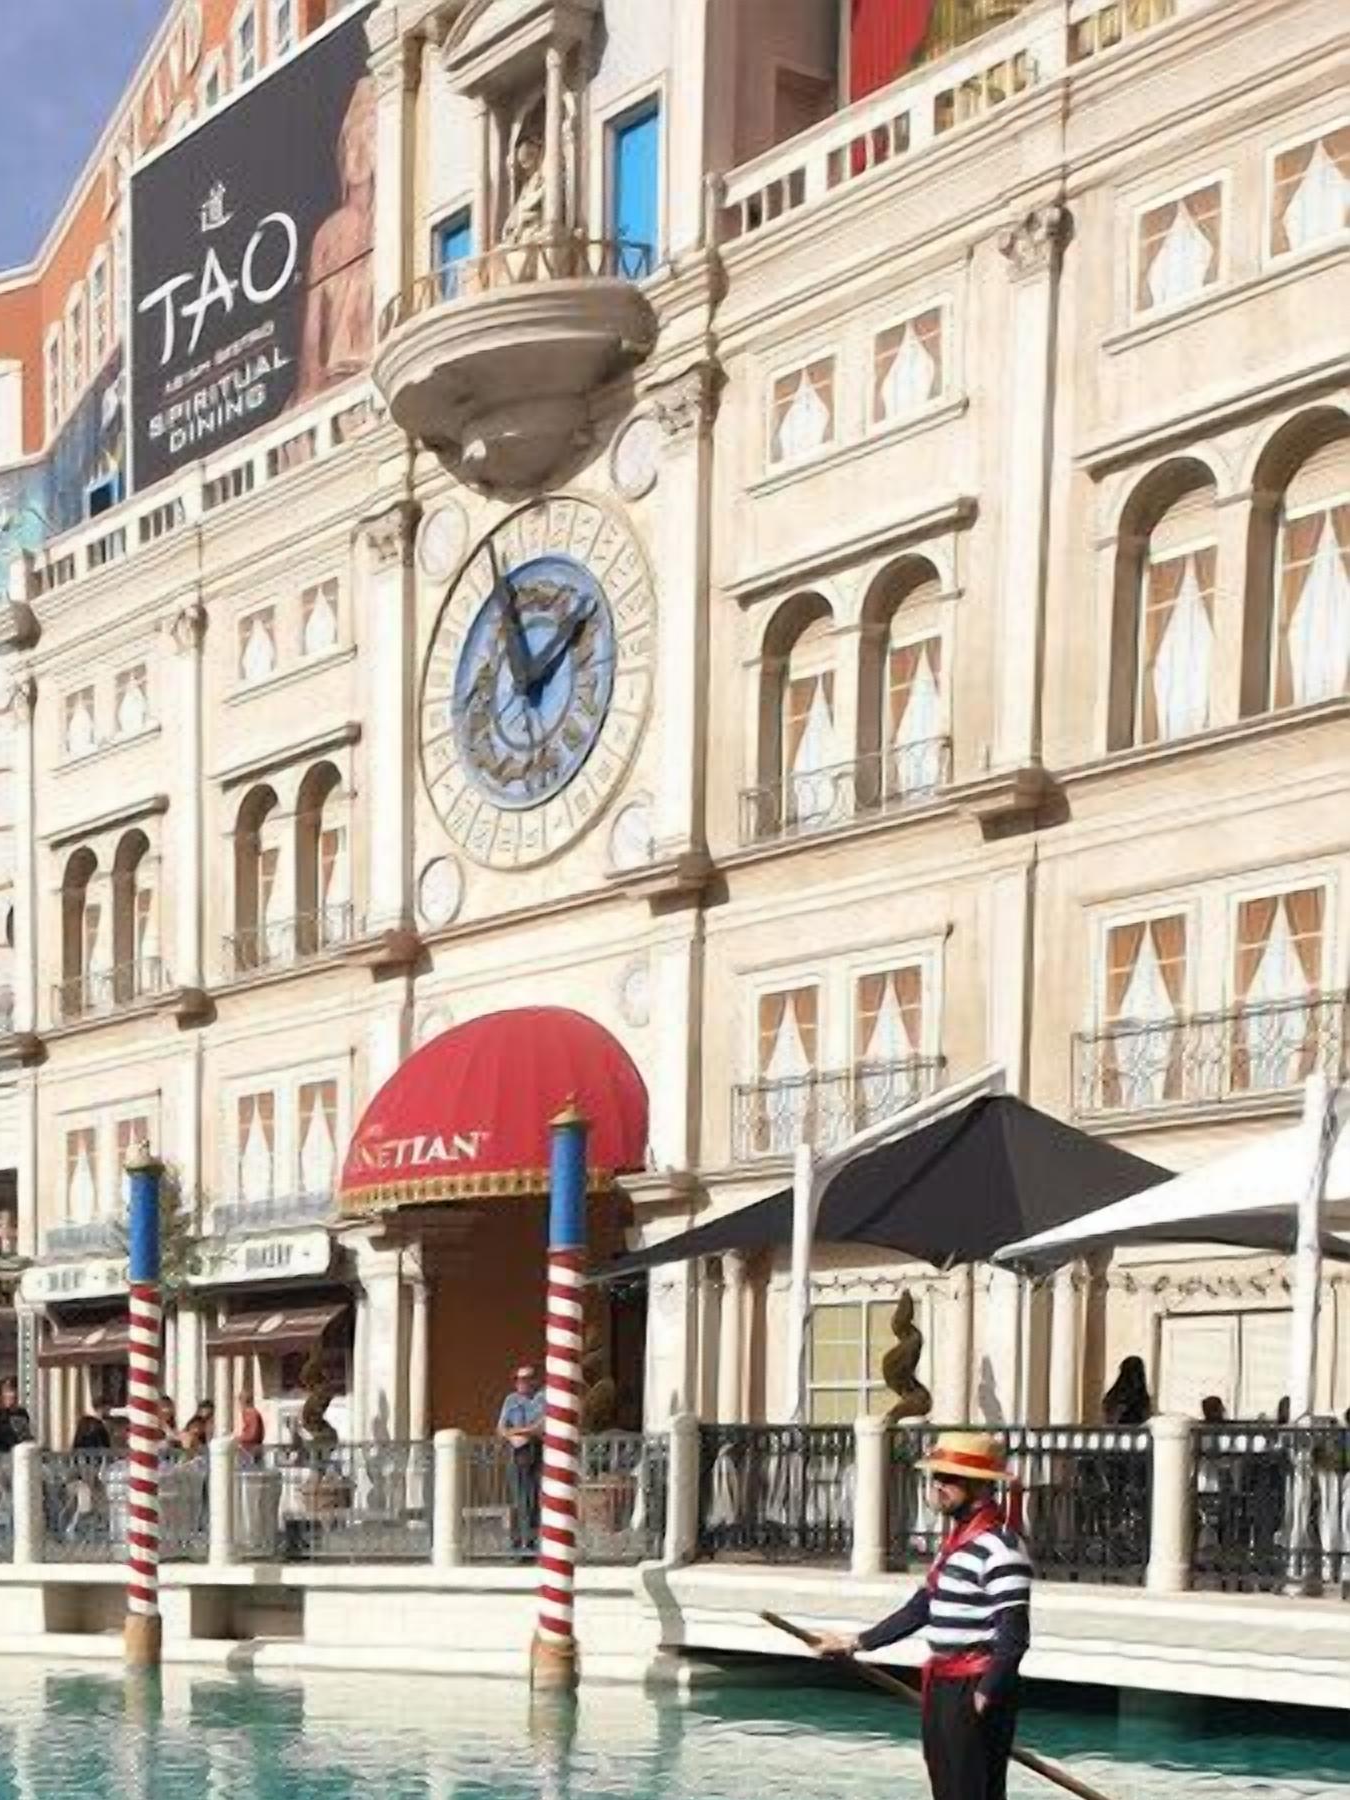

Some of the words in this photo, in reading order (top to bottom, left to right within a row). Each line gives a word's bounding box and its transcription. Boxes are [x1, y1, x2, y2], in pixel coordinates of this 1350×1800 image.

[137, 211, 298, 366] TAO
[149, 347, 291, 440] SPIRITUAL
[169, 384, 267, 453] DINING
